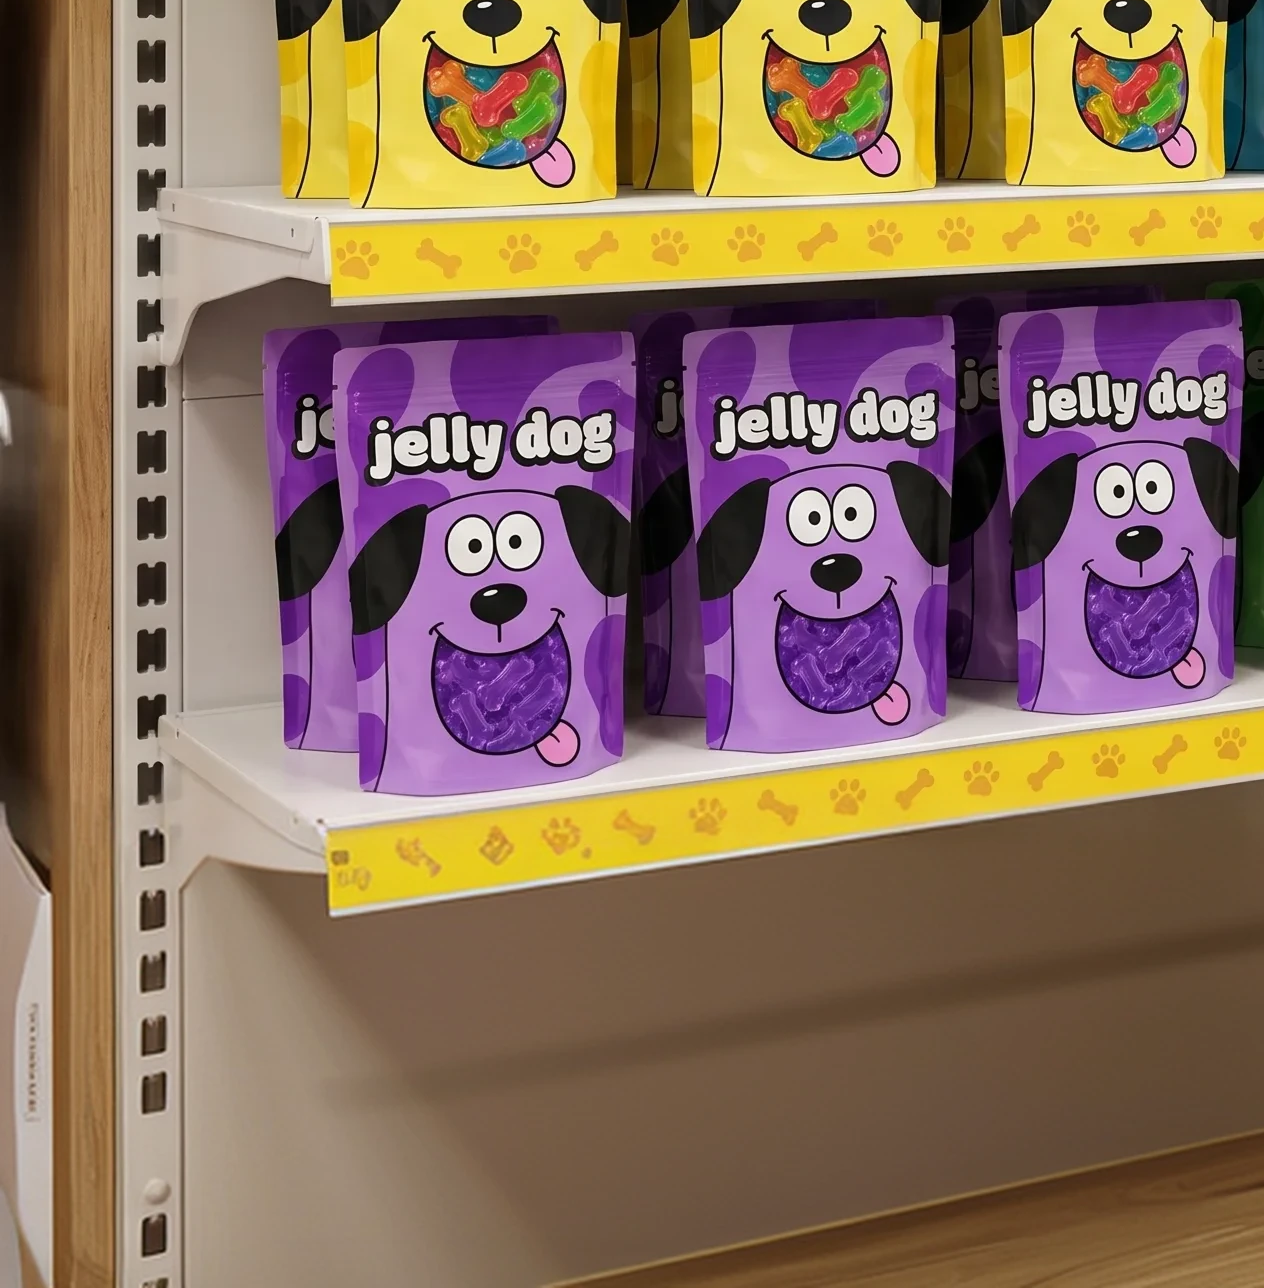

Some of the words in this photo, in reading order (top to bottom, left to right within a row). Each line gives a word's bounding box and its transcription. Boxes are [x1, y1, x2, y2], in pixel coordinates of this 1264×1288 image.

[713, 392, 840, 457] jelly
[847, 388, 939, 443] dog
[1025, 372, 1140, 435] jelly
[1146, 368, 1229, 422] dog
[367, 413, 505, 482] jelly
[513, 408, 615, 466] dog
